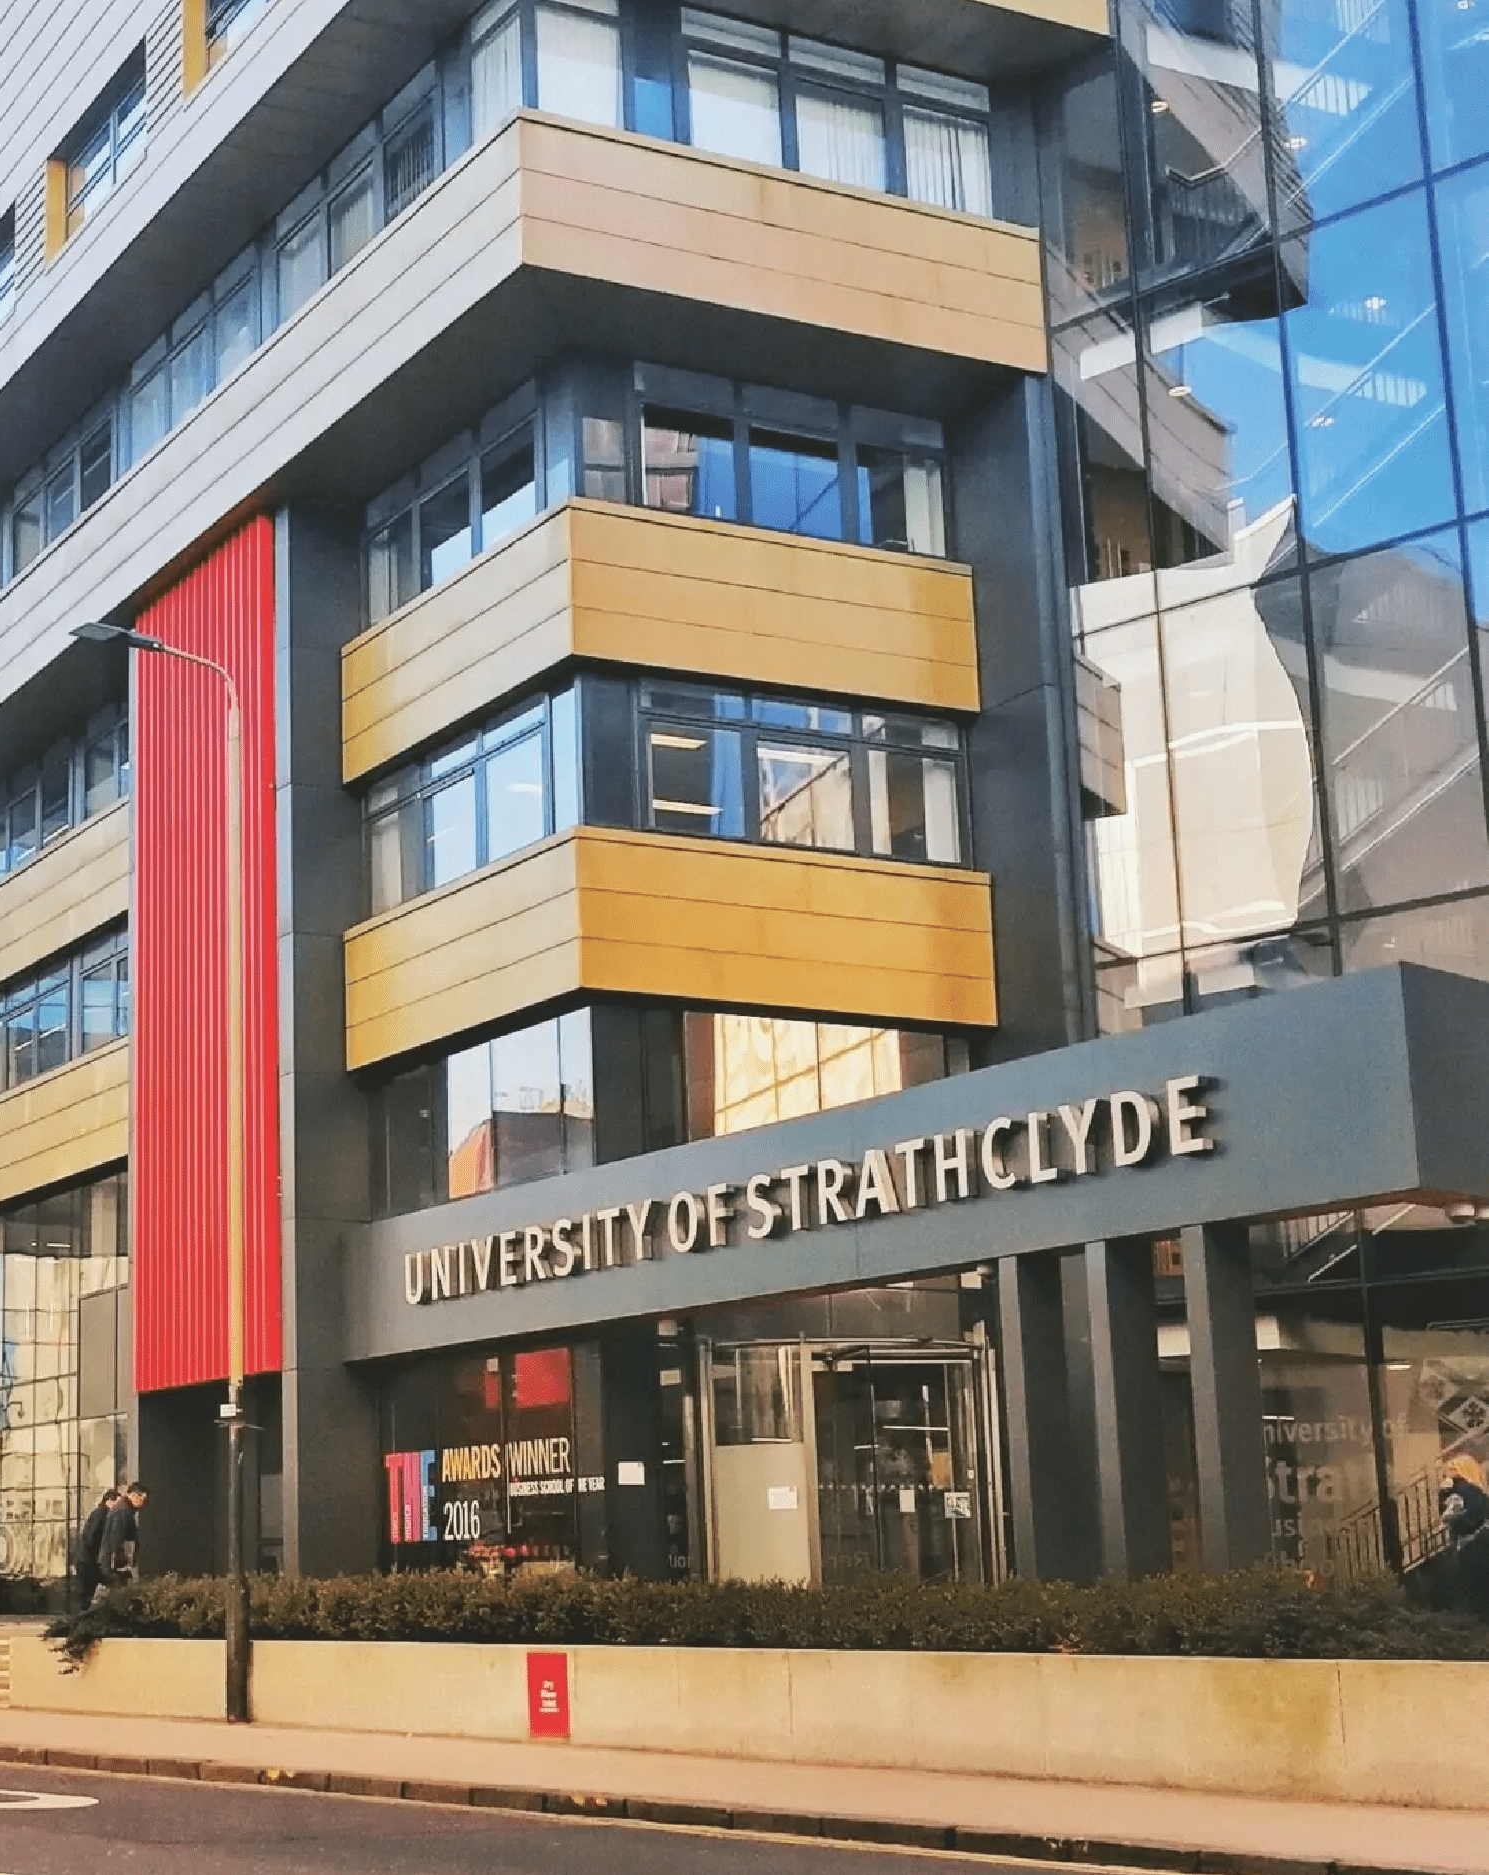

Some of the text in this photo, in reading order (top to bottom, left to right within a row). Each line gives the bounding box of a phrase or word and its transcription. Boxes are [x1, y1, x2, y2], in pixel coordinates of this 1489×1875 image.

[404, 1075, 1214, 1304] UNIVERSITY OF STRATHCLYDE
[1263, 1414, 1373, 1446] niversity
[442, 1437, 571, 1483] AWARDS WINNER
[385, 1449, 438, 1542] THE
[443, 1500, 481, 1541] 2016
